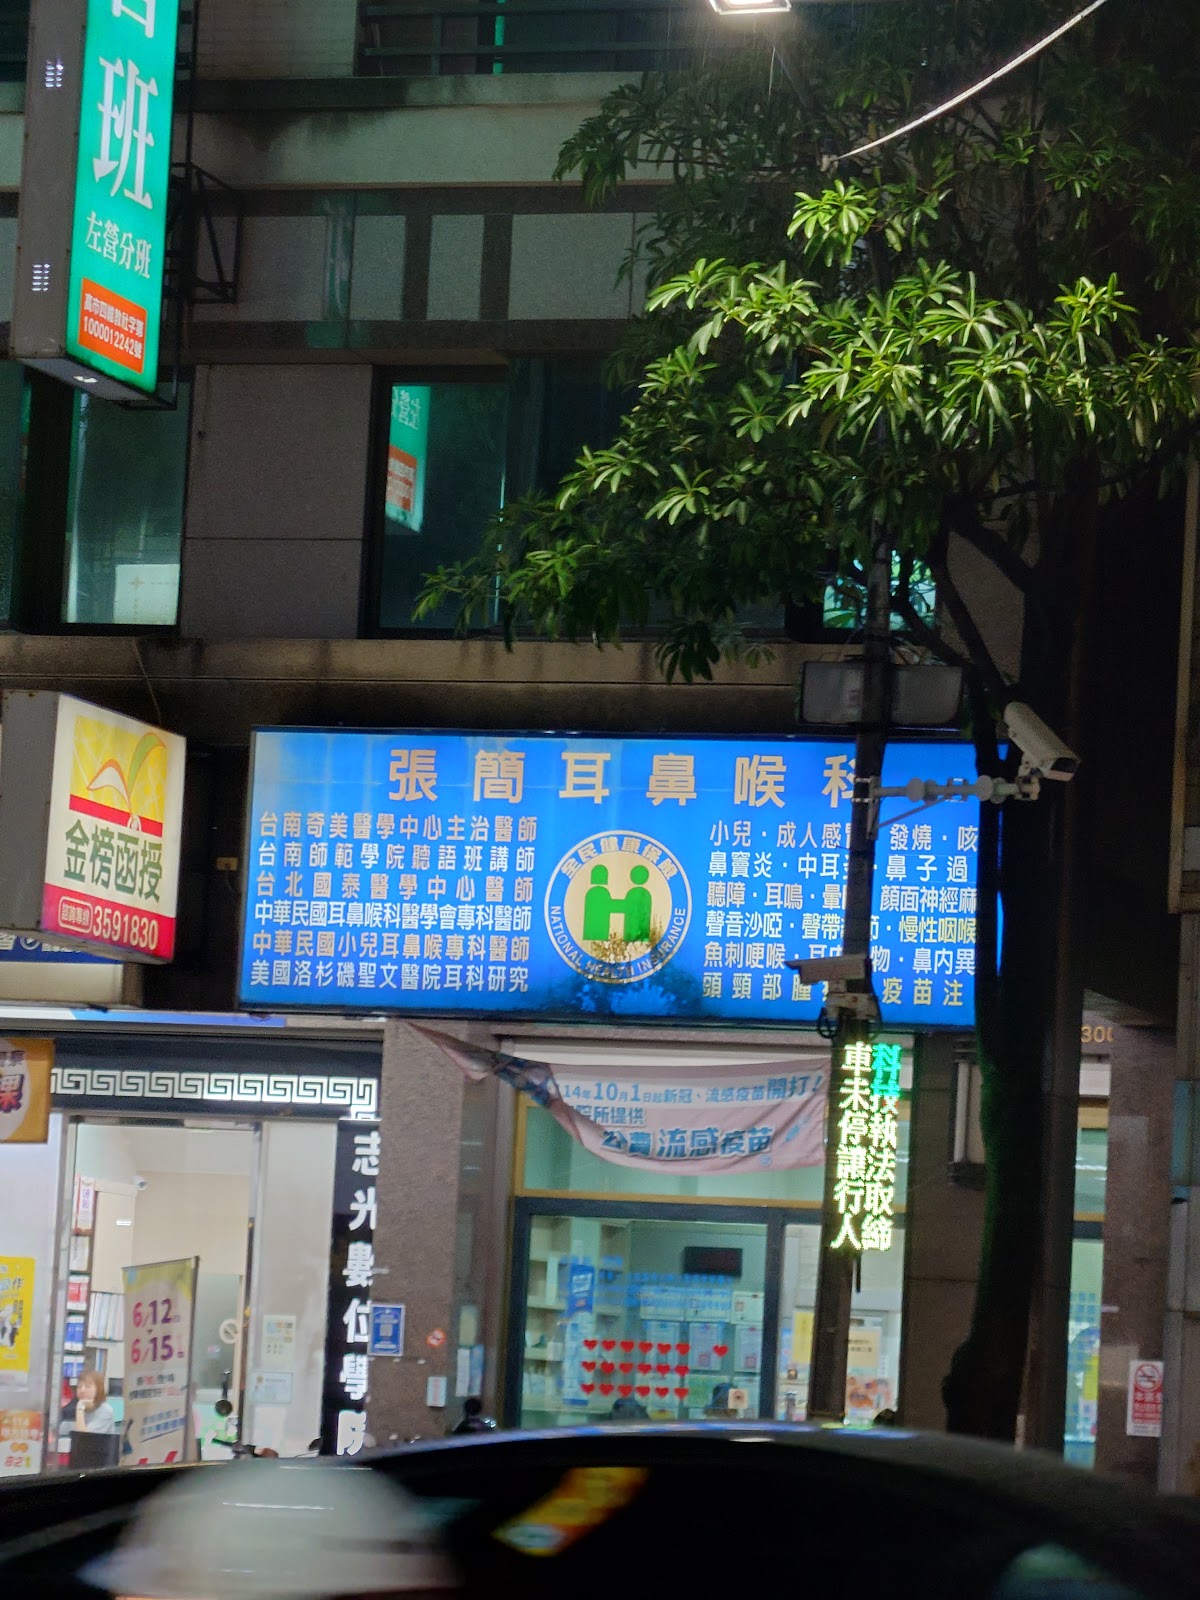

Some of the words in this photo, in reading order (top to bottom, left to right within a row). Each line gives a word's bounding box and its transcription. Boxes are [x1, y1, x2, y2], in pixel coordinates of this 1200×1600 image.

[85, 211, 152, 279] 左營分班
[388, 749, 857, 808] 張簡耳鼻喉科
[259, 811, 537, 843] 台南奇美醫學中心主治醫師
[64, 819, 163, 903] 金榜函授
[258, 841, 535, 873] 台南師範學院聽語班講師
[561, 836, 679, 880] 全民健康保險
[256, 870, 533, 903] 台北國泰醫學中心醫師
[93, 904, 159, 950] 3591830
[254, 900, 532, 932] 中華民國耳鼻喉科醫學會專科醫師
[252, 930, 530, 962] 中華民國小兒耳鼻喉專科醫師
[551, 905, 583, 966] NATIONAL
[585, 960, 634, 979] HEALTH
[637, 907, 686, 973] INSURANCE
[250, 959, 529, 993] 美國洛杉磯聖文醫院耳科研究
[830, 1041, 873, 1250] 車未停讓行人
[861, 1042, 902, 1251] 科技執法取締
[133, 1299, 172, 1328] 6/12
[131, 1335, 174, 1365] 6/15
